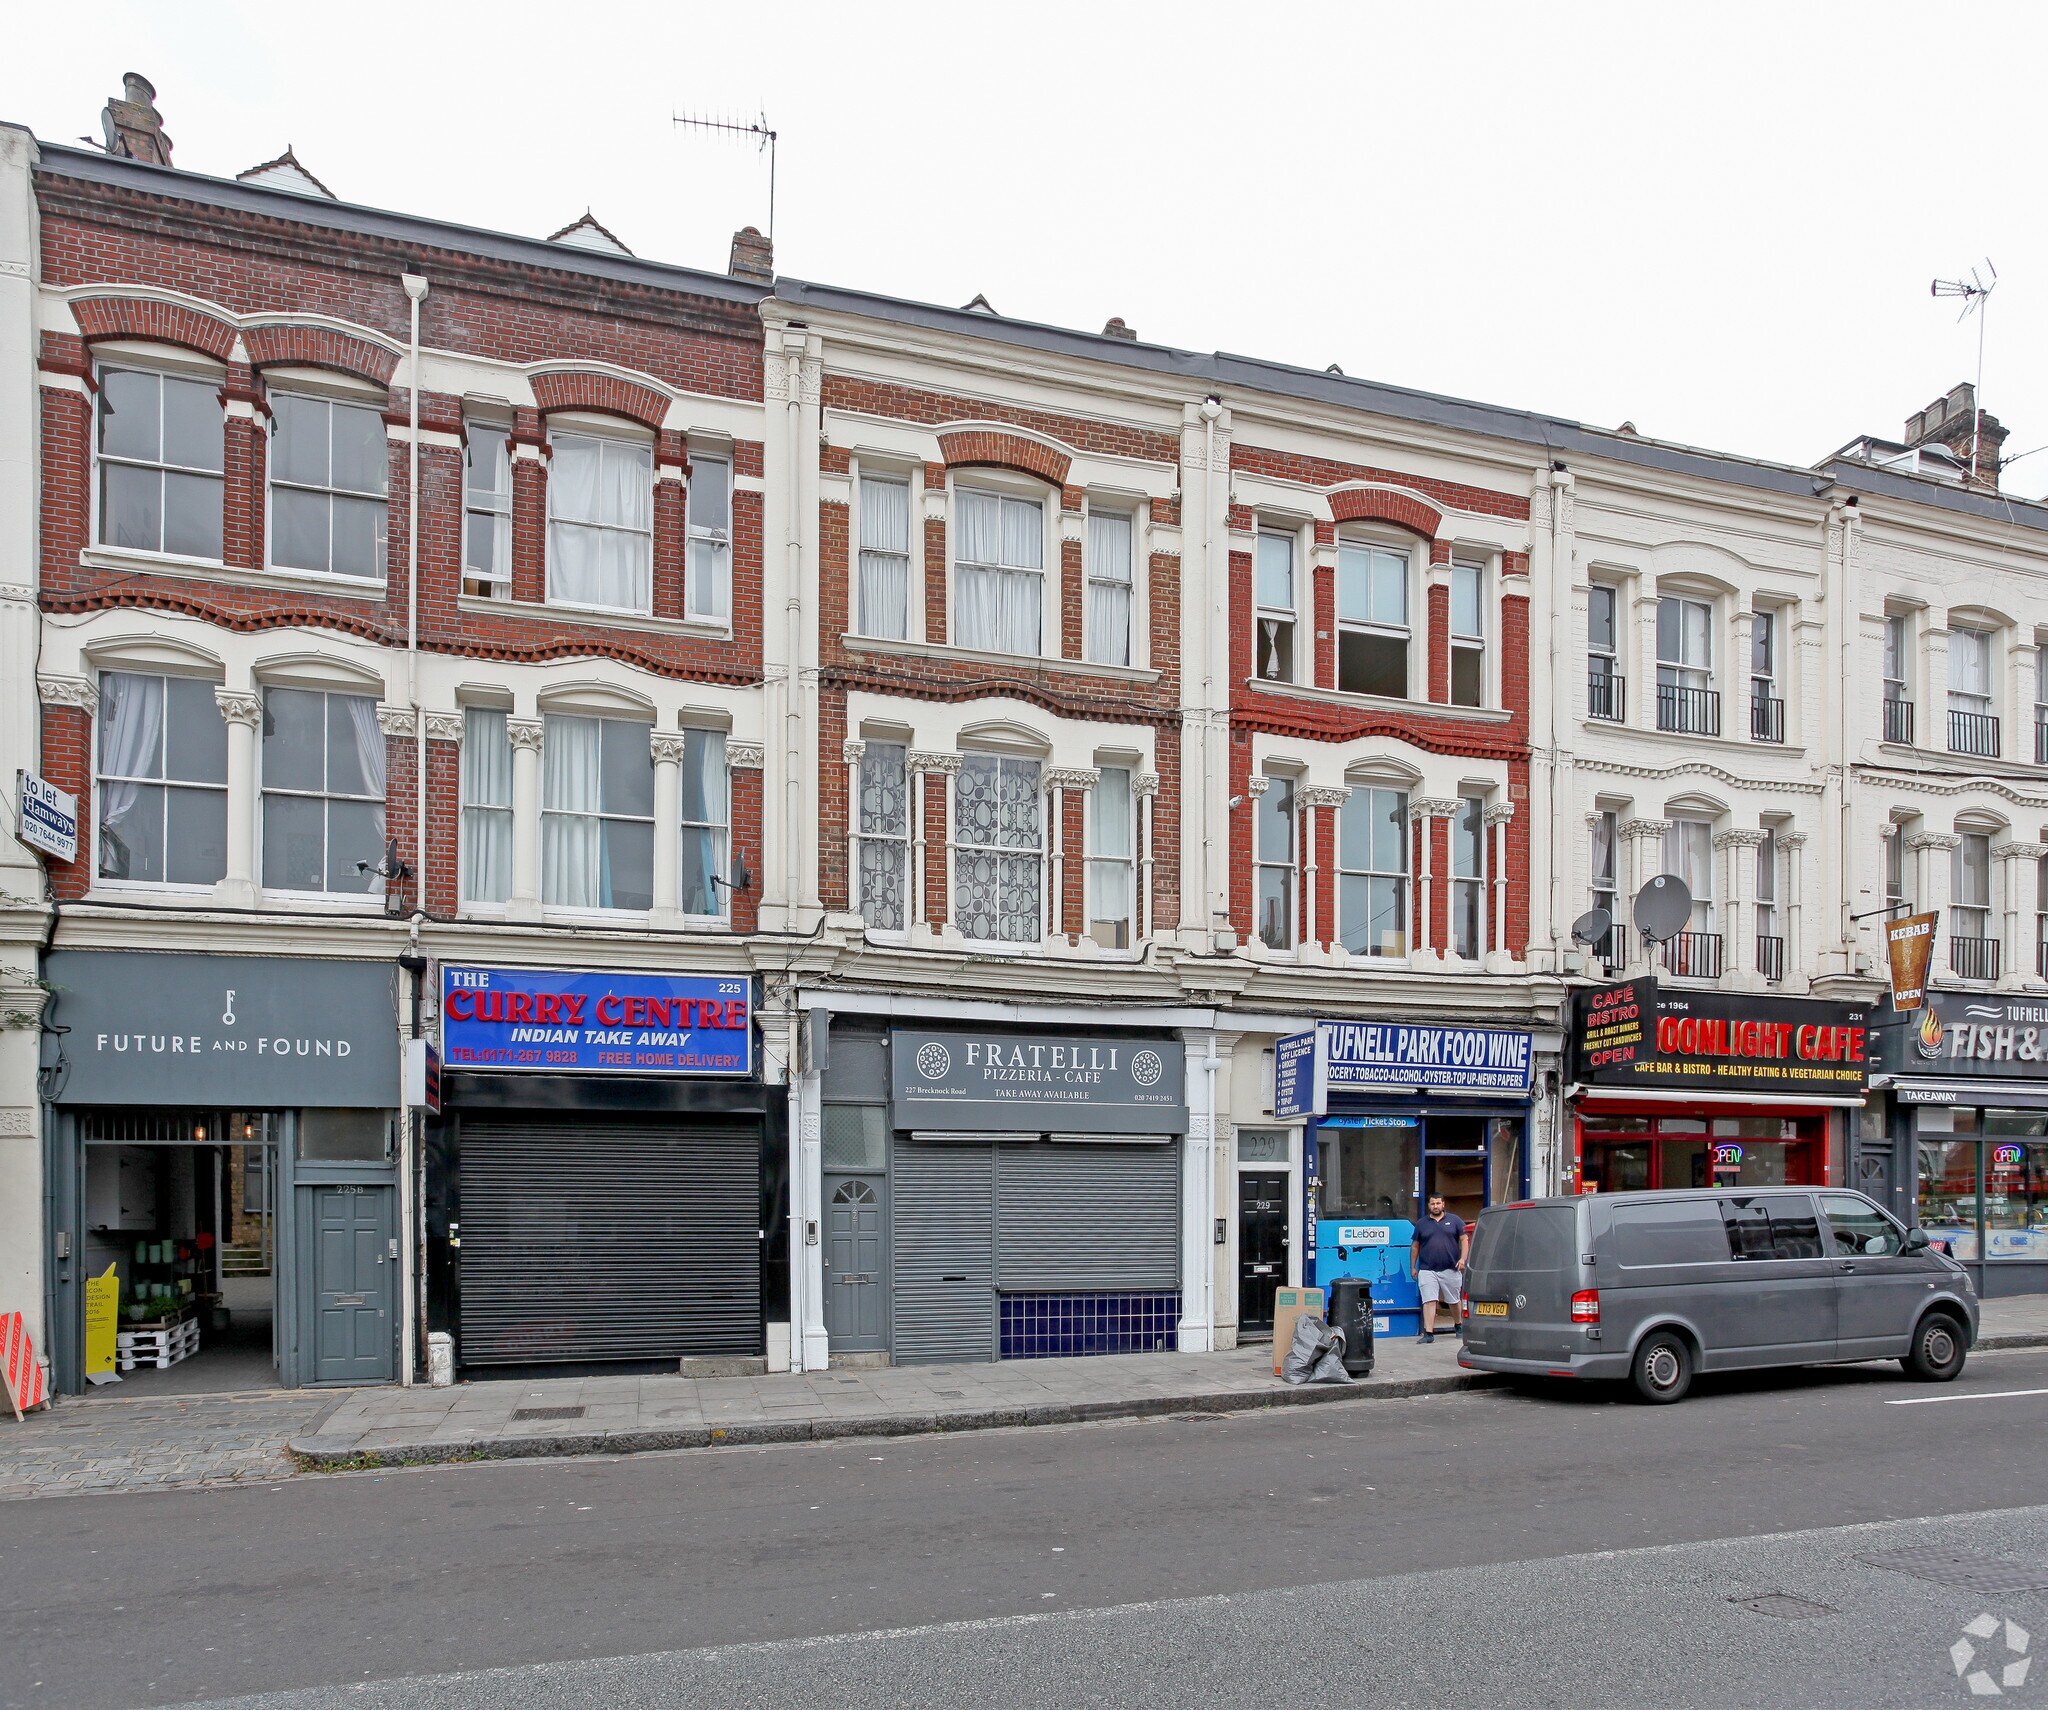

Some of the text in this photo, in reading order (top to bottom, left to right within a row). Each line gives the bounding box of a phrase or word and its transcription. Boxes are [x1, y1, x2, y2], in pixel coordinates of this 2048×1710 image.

[26, 775, 57, 807] to let
[24, 795, 75, 834] Hamways
[25, 820, 37, 834] 020
[1890, 923, 1929, 941] KEBAB
[451, 971, 489, 988] THE
[718, 983, 741, 994] 225
[1592, 984, 1634, 1009] CAFÉ
[1896, 988, 1921, 1001] OPEN
[445, 988, 747, 1030] CURRY CENTRE
[1669, 1002, 1689, 1010] 1964
[2007, 1006, 2048, 1022] TUFNELL
[1587, 1004, 1640, 1027] BISTRO
[510, 1028, 692, 1047] INDIAN TAKE AWAY
[1587, 1021, 1639, 1039] GRILL & ROAST DINNERS
[97, 1034, 351, 1057] FUTURE AND FOUND
[1279, 1036, 1315, 1051] TUFNELL PARK
[1397, 1028, 1442, 1064] PARK
[1443, 1031, 1486, 1065] FOOD
[1488, 1033, 1529, 1067] WINE
[1583, 1032, 1642, 1051] FRESHLY CUT SANDWICHES
[1796, 1023, 1866, 1062] CAFE
[1951, 1023, 2043, 1061] FISH &
[452, 1047, 578, 1063] TEL:0171-267 9828
[598, 1051, 741, 1067] FREE HOME DELIVERY
[966, 1043, 1118, 1071] FRATELLI
[1280, 1046, 1311, 1060] OFF LICENCE
[1590, 1046, 1635, 1066] OPEN
[1282, 1059, 1297, 1069] GROCERY
[1657, 1062, 1673, 1073] BAR
[1674, 1063, 1681, 1074] &
[1683, 1063, 1711, 1075] BISTRO
[1717, 1065, 1752, 1077] HEALTHY
[1754, 1066, 1780, 1078] EATING
[1782, 1067, 1787, 1078] &
[1789, 1068, 1834, 1080] VEGETARIAN
[1836, 1070, 1863, 1081] CHOICE
[983, 1068, 1052, 1081] PIZZERIA
[1064, 1071, 1101, 1083] CAFE
[994, 1089, 1089, 1099] TAKE AWAY AVAILABLE
[1905, 1091, 1957, 1101] TAKEAWAY
[1338, 1116, 1406, 1126] oyster Ticket Stop
[1250, 1136, 1276, 1157] 229
[1713, 1149, 1740, 1162] OPEN
[1994, 1149, 2019, 1162] OPEN
[337, 1185, 364, 1194] 225B
[1256, 1201, 1271, 1210] 229
[1353, 1229, 1384, 1238] Lebara
[10, 1322, 20, 1374] INTERIORS
[22, 1345, 31, 1400] FURNITURE
[34, 1373, 42, 1399] GIFTS
